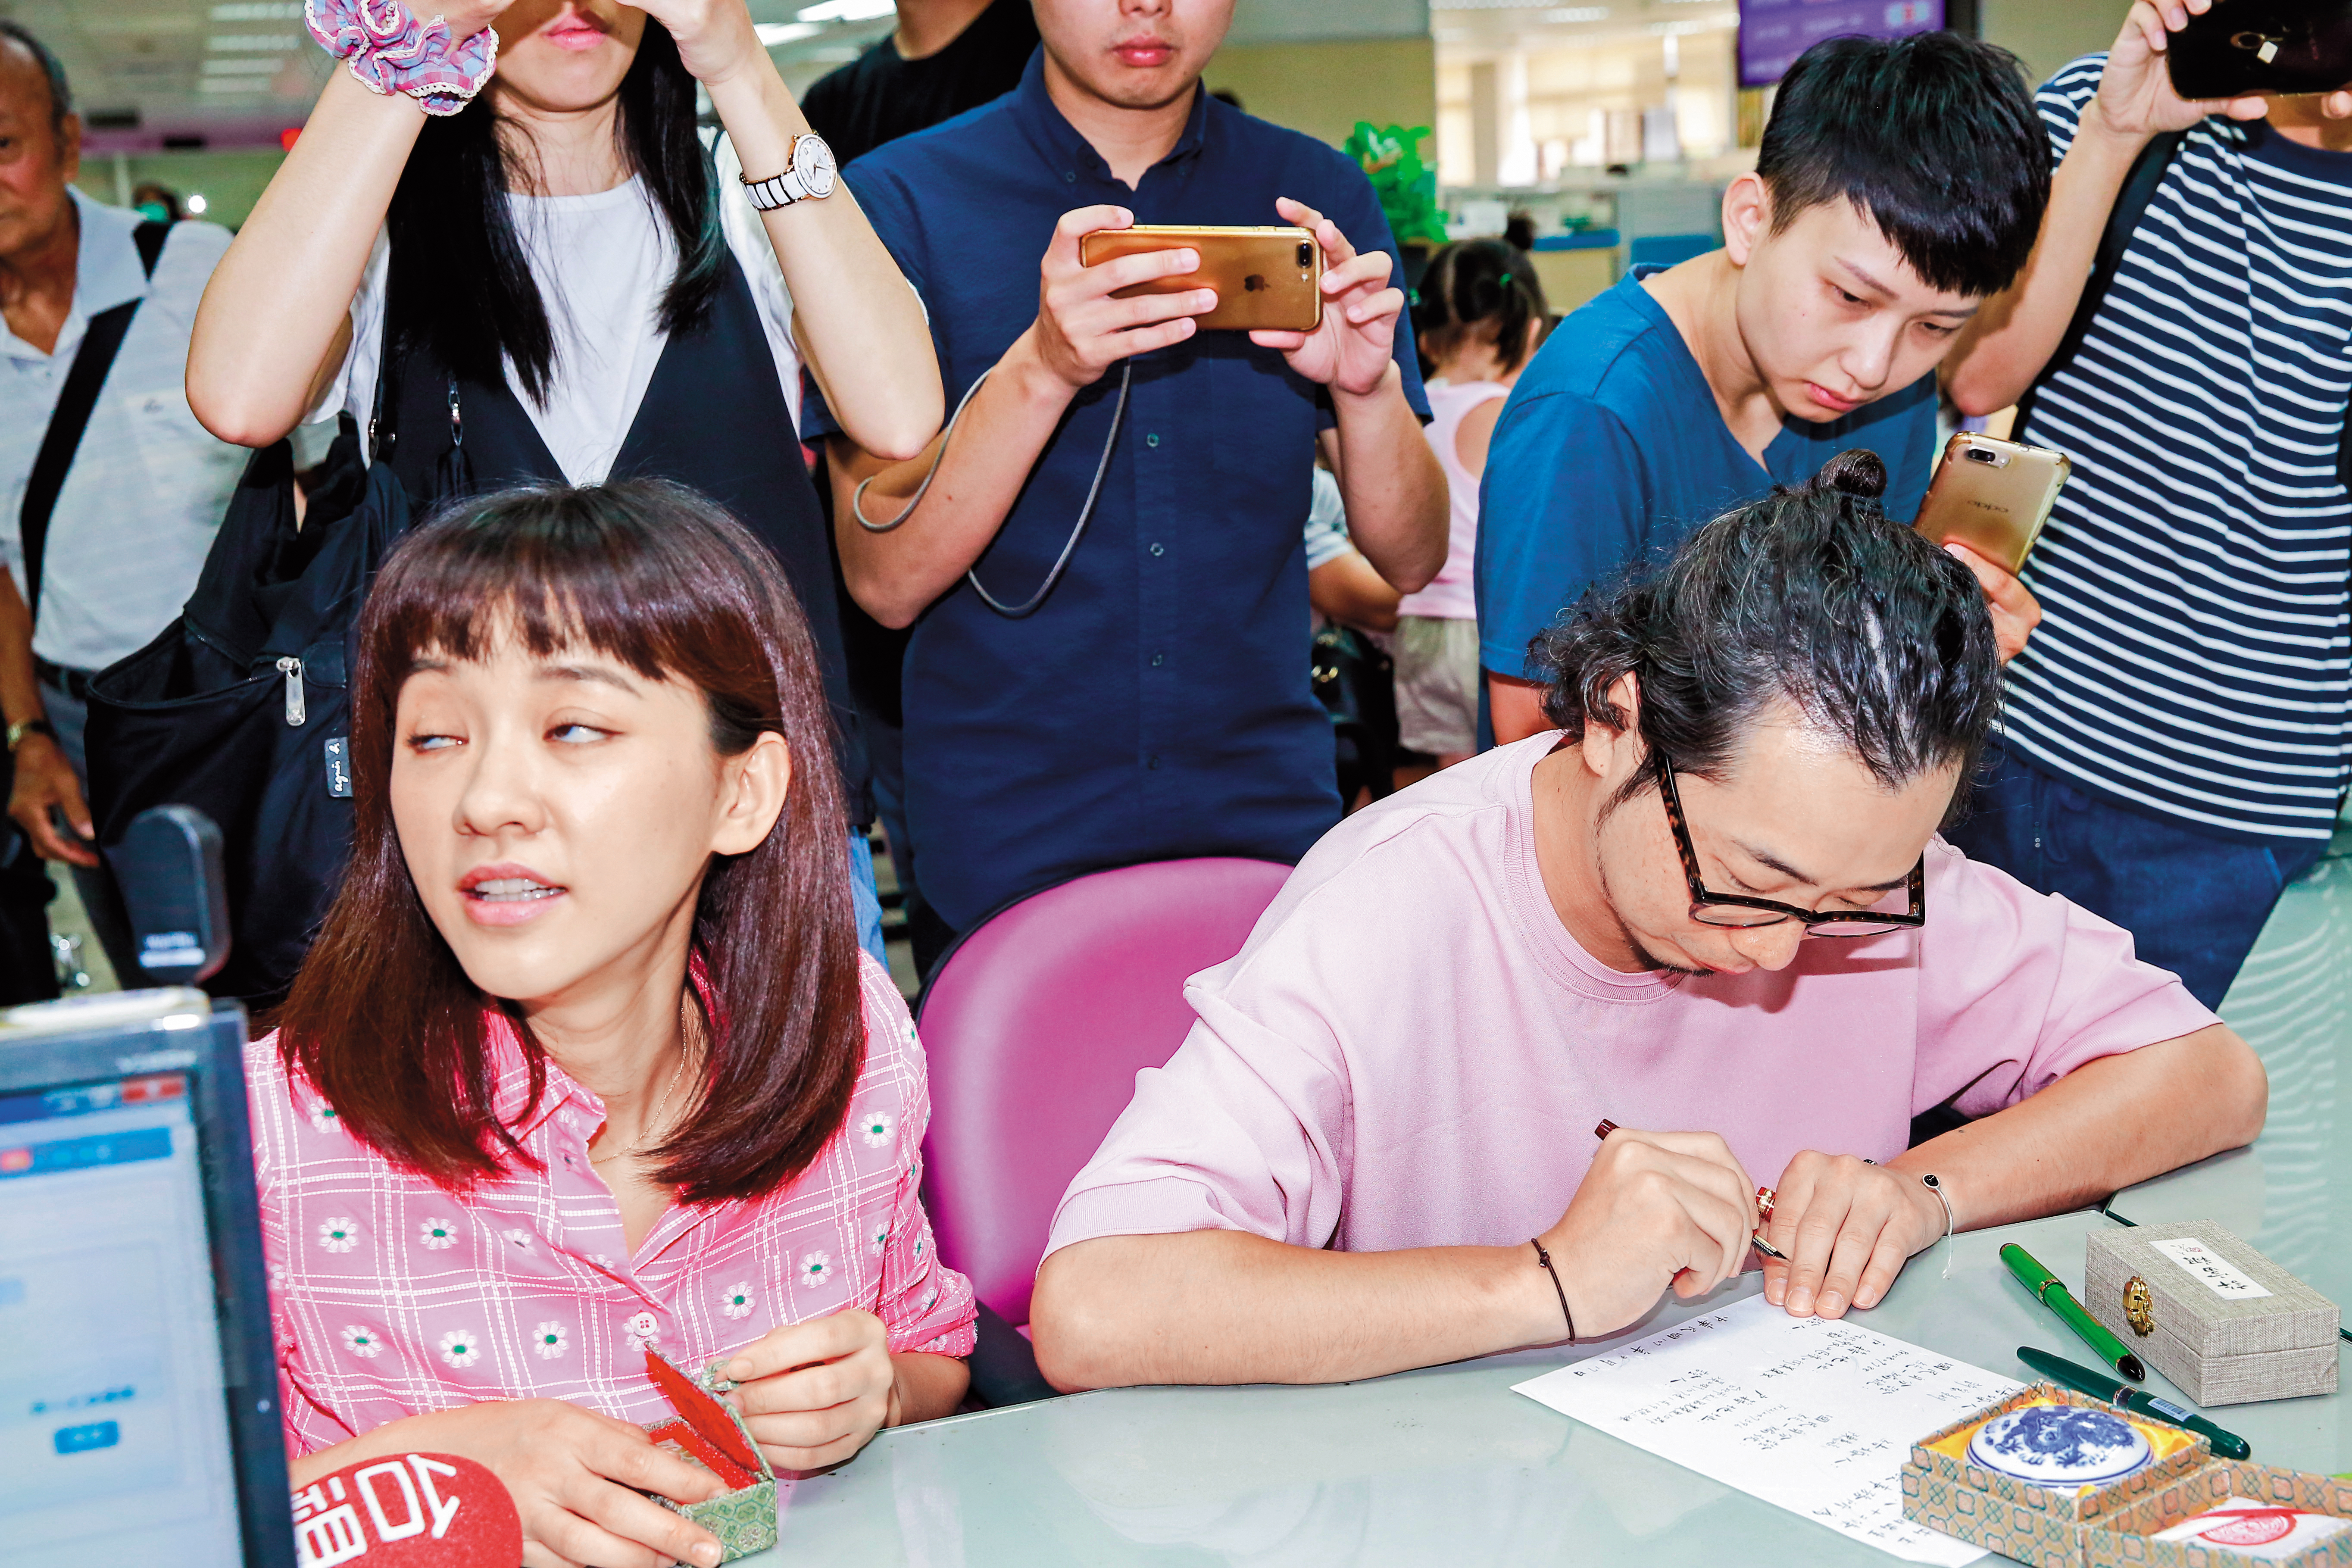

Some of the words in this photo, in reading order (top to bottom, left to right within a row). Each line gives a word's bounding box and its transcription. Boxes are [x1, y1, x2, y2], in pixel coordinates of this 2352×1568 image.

[2182, 1256, 2249, 1290] 許富翔
[1879, 1362, 1954, 1395] 國民身分證
[1758, 1415, 1833, 1450] 國民身分證
